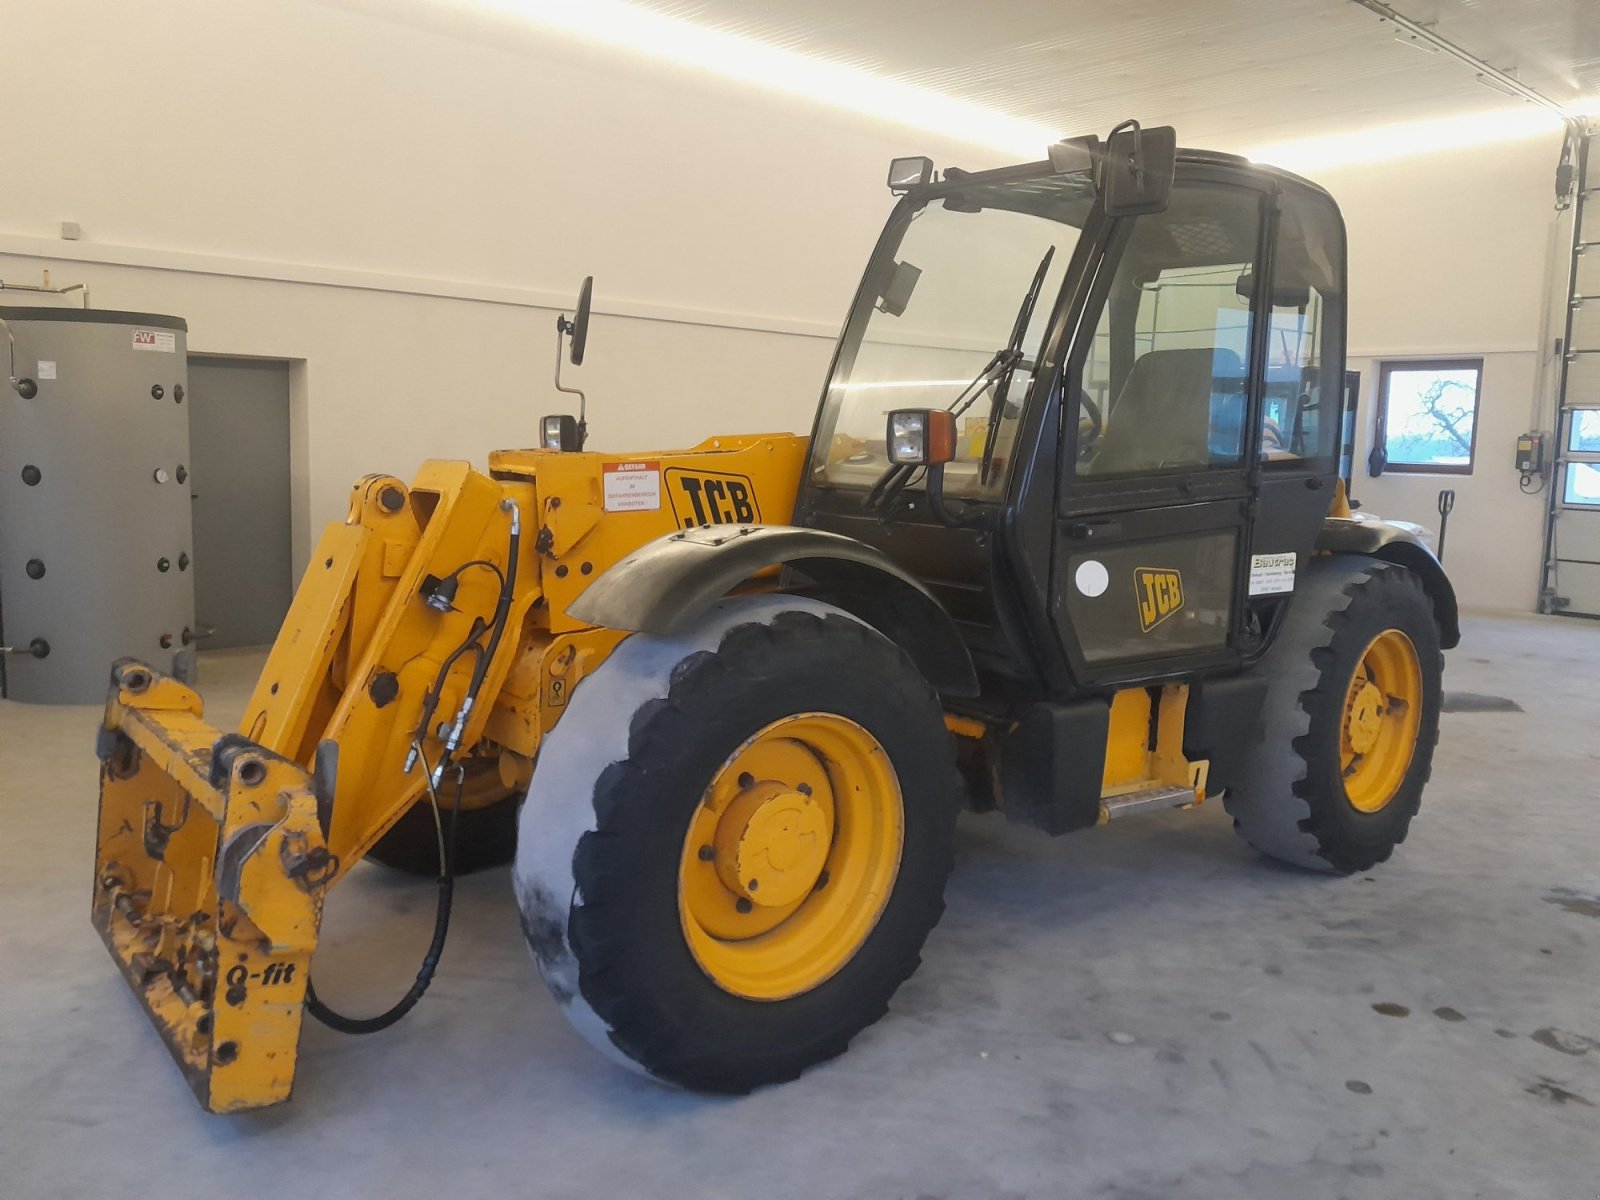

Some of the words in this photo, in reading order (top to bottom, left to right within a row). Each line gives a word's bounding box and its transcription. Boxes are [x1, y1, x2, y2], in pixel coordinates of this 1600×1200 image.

[607, 491, 657, 499] GEFAHRENBEREICH
[680, 476, 754, 526] JCB
[1142, 573, 1181, 626] JCB
[226, 962, 296, 988] Q-fit
